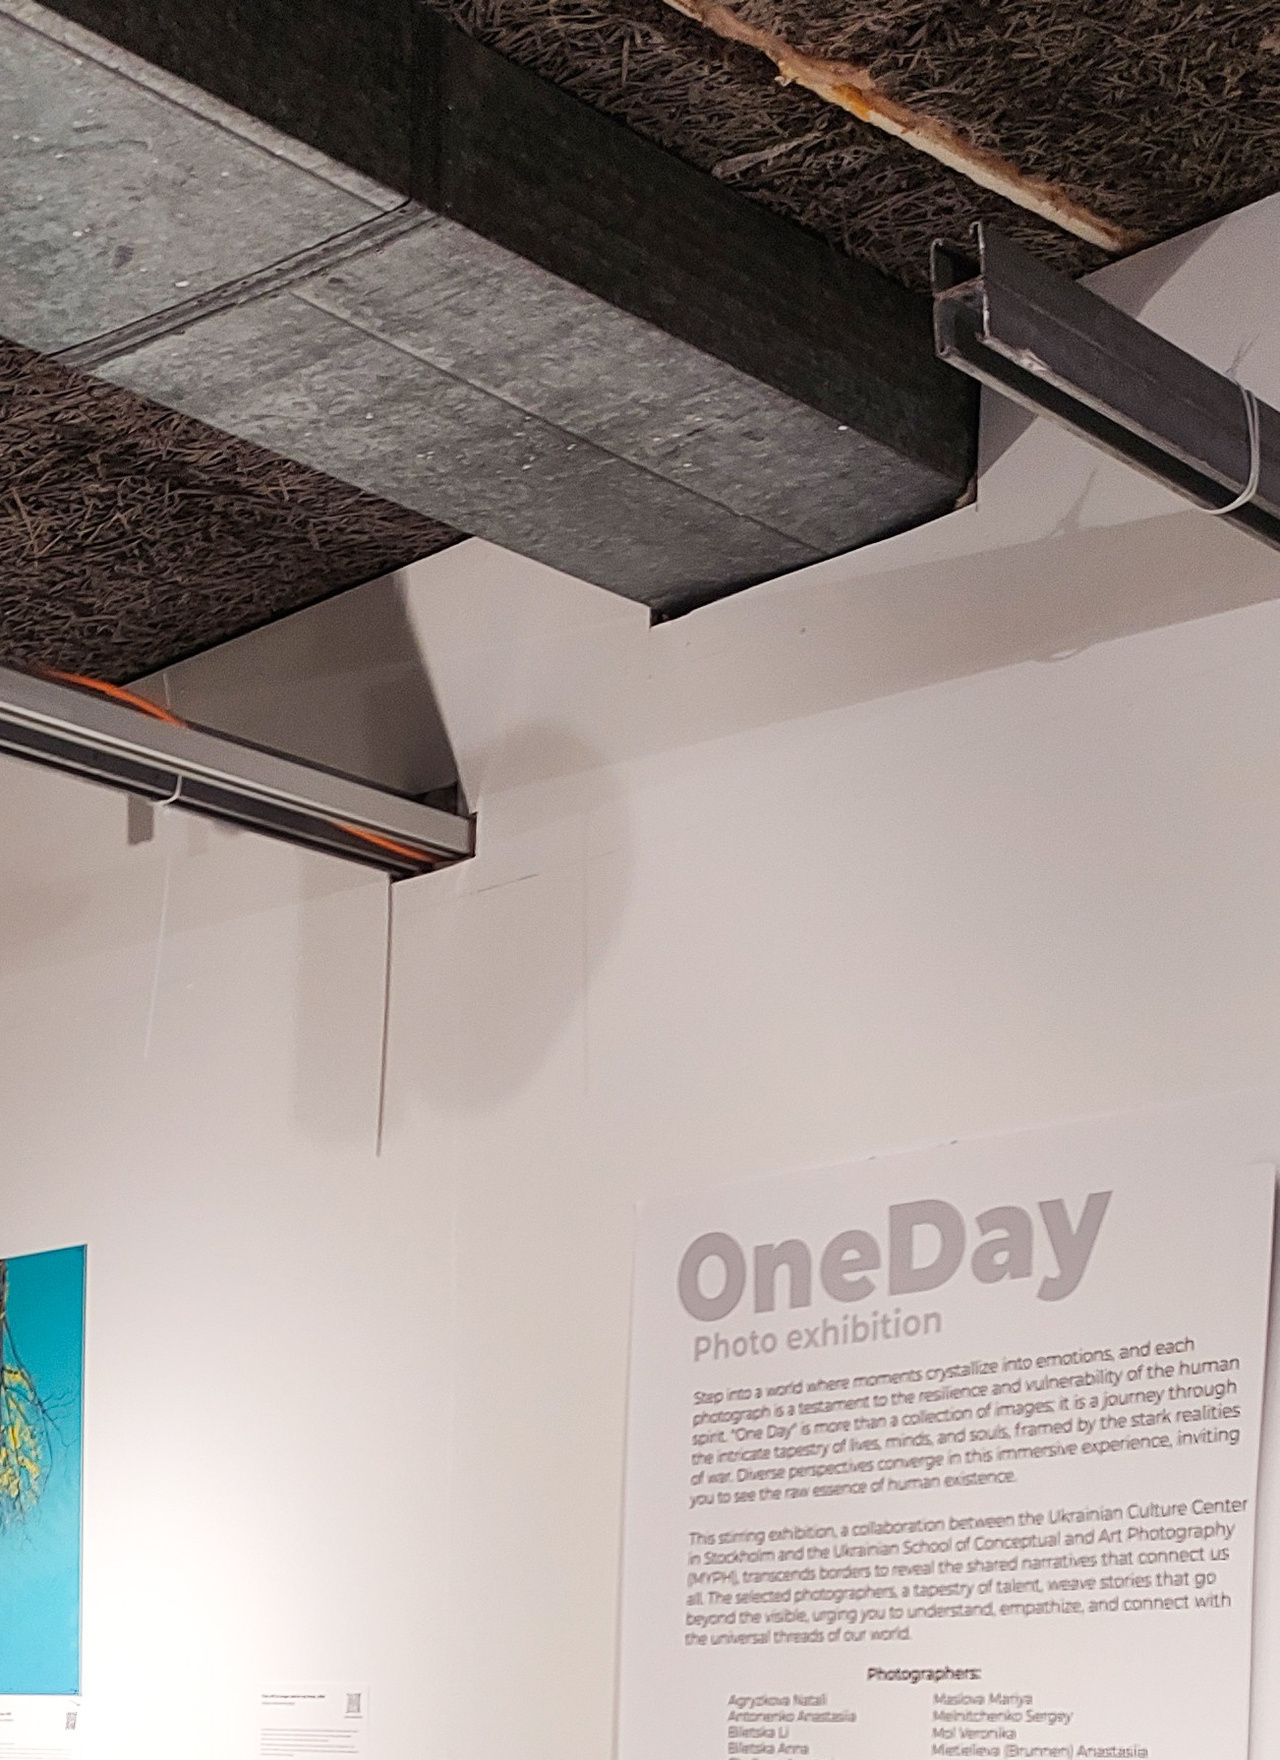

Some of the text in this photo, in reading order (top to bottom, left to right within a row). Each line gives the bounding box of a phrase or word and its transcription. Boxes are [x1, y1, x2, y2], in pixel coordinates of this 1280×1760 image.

[677, 1190, 1114, 1322] OneDay
[694, 1309, 943, 1362] Photo exhibition
[693, 1389, 724, 1406] Step
[726, 1386, 752, 1401] into
[754, 1385, 763, 1398] a
[765, 1378, 803, 1397] world
[806, 1375, 850, 1393] where
[852, 1367, 923, 1388] moments
[925, 1359, 999, 1383] crystallize
[1002, 1356, 1033, 1372] into
[1118, 1340, 1151, 1360] and
[1154, 1335, 1195, 1356] each
[693, 1358, 1240, 1428] photograph is a testament to the resilience and vulnerability of the human
[799, 1420, 811, 1436] is
[813, 1419, 851, 1435] more
[853, 1414, 887, 1431] than
[889, 1414, 899, 1427] a
[901, 1406, 973, 1426] collection
[975, 1402, 992, 1420] of
[1058, 1396, 1071, 1412] it
[1070, 1394, 1086, 1411] is
[1088, 1395, 1101, 1409] a
[1100, 1389, 1165, 1412] journey
[1168, 1378, 1237, 1402] through
[690, 1469, 705, 1485] of
[736, 1465, 786, 1482] Diverse
[788, 1457, 875, 1481] perspectives
[876, 1452, 944, 1470] converge
[947, 1449, 962, 1464] in
[964, 1446, 993, 1463] this
[995, 1439, 1078, 1461] immersive
[1176, 1426, 1240, 1446] inviting
[691, 1448, 714, 1465] the
[716, 1445, 771, 1463] intricate
[773, 1440, 831, 1460] tapestry
[830, 1436, 847, 1453] of
[937, 1425, 966, 1444] and
[1014, 1416, 1073, 1437] framed
[1076, 1414, 1097, 1435] by
[1099, 1412, 1127, 1430] the
[1129, 1407, 1172, 1427] stark
[1175, 1403, 1241, 1423] realities
[689, 1492, 715, 1509] you
[717, 1490, 732, 1504] to
[733, 1489, 757, 1502] see
[758, 1484, 782, 1501] the
[784, 1485, 810, 1499] raw
[812, 1481, 868, 1497] essence
[870, 1476, 885, 1493] of
[887, 1475, 941, 1492] human
[688, 1530, 716, 1547] This
[718, 1528, 765, 1546] stirring
[840, 1525, 849, 1537] a
[851, 1517, 945, 1537] collaboration
[948, 1514, 1015, 1531] between
[1017, 1509, 1044, 1527] the
[1048, 1505, 1123, 1525] Ukrainian
[1126, 1502, 1188, 1520] Culture
[1190, 1499, 1248, 1516] Center
[688, 1522, 1236, 1566] in Stockholm and the Ukrainian School of Conceptual and Art Photography
[707, 1590, 733, 1606] The
[735, 1587, 792, 1604] selected
[901, 1585, 910, 1598] a
[913, 1581, 975, 1600] tapestry
[976, 1578, 993, 1594] of
[1046, 1577, 1097, 1592] weave
[1099, 1572, 1152, 1589] stories
[1155, 1570, 1190, 1587] that
[1192, 1571, 1217, 1589] go
[742, 1564, 817, 1583] transcends
[819, 1562, 872, 1579] borders
[874, 1562, 889, 1577] to
[891, 1558, 935, 1576] reveal
[937, 1557, 964, 1574] the
[965, 1554, 1018, 1572] shared
[1021, 1551, 1098, 1570] narratives
[1100, 1549, 1134, 1566] that
[1136, 1546, 1206, 1564] connect
[1208, 1547, 1229, 1561] us
[686, 1609, 736, 1629] beyond
[739, 1608, 762, 1624] the
[811, 1606, 858, 1625] urging
[860, 1607, 886, 1624] you
[889, 1605, 904, 1619] to
[1087, 1596, 1119, 1613] and
[1121, 1595, 1189, 1612] connect
[1193, 1592, 1231, 1610] with
[685, 1630, 708, 1646] the
[710, 1629, 771, 1645] universal
[773, 1627, 825, 1644] threads
[827, 1627, 842, 1643] of
[841, 1630, 867, 1642] our
